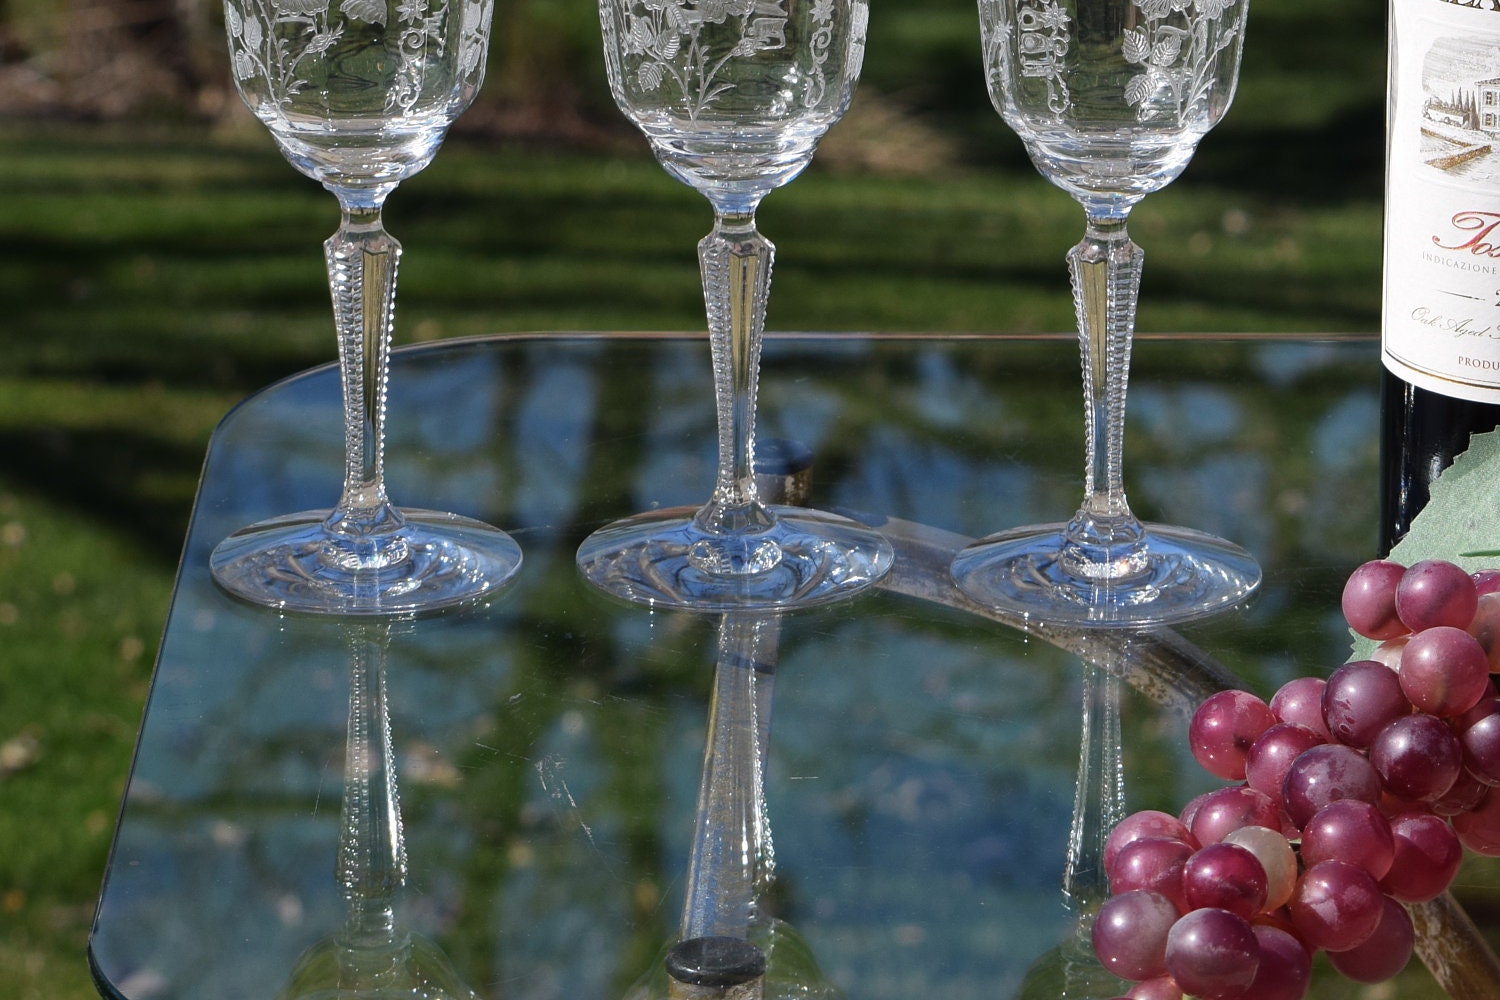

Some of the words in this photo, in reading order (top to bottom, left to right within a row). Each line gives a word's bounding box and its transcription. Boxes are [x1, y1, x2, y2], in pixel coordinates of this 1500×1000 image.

[1422, 251, 1497, 275] INDICAZIONE
[1411, 307, 1438, 327] Oak
[1439, 319, 1484, 338] Aged
